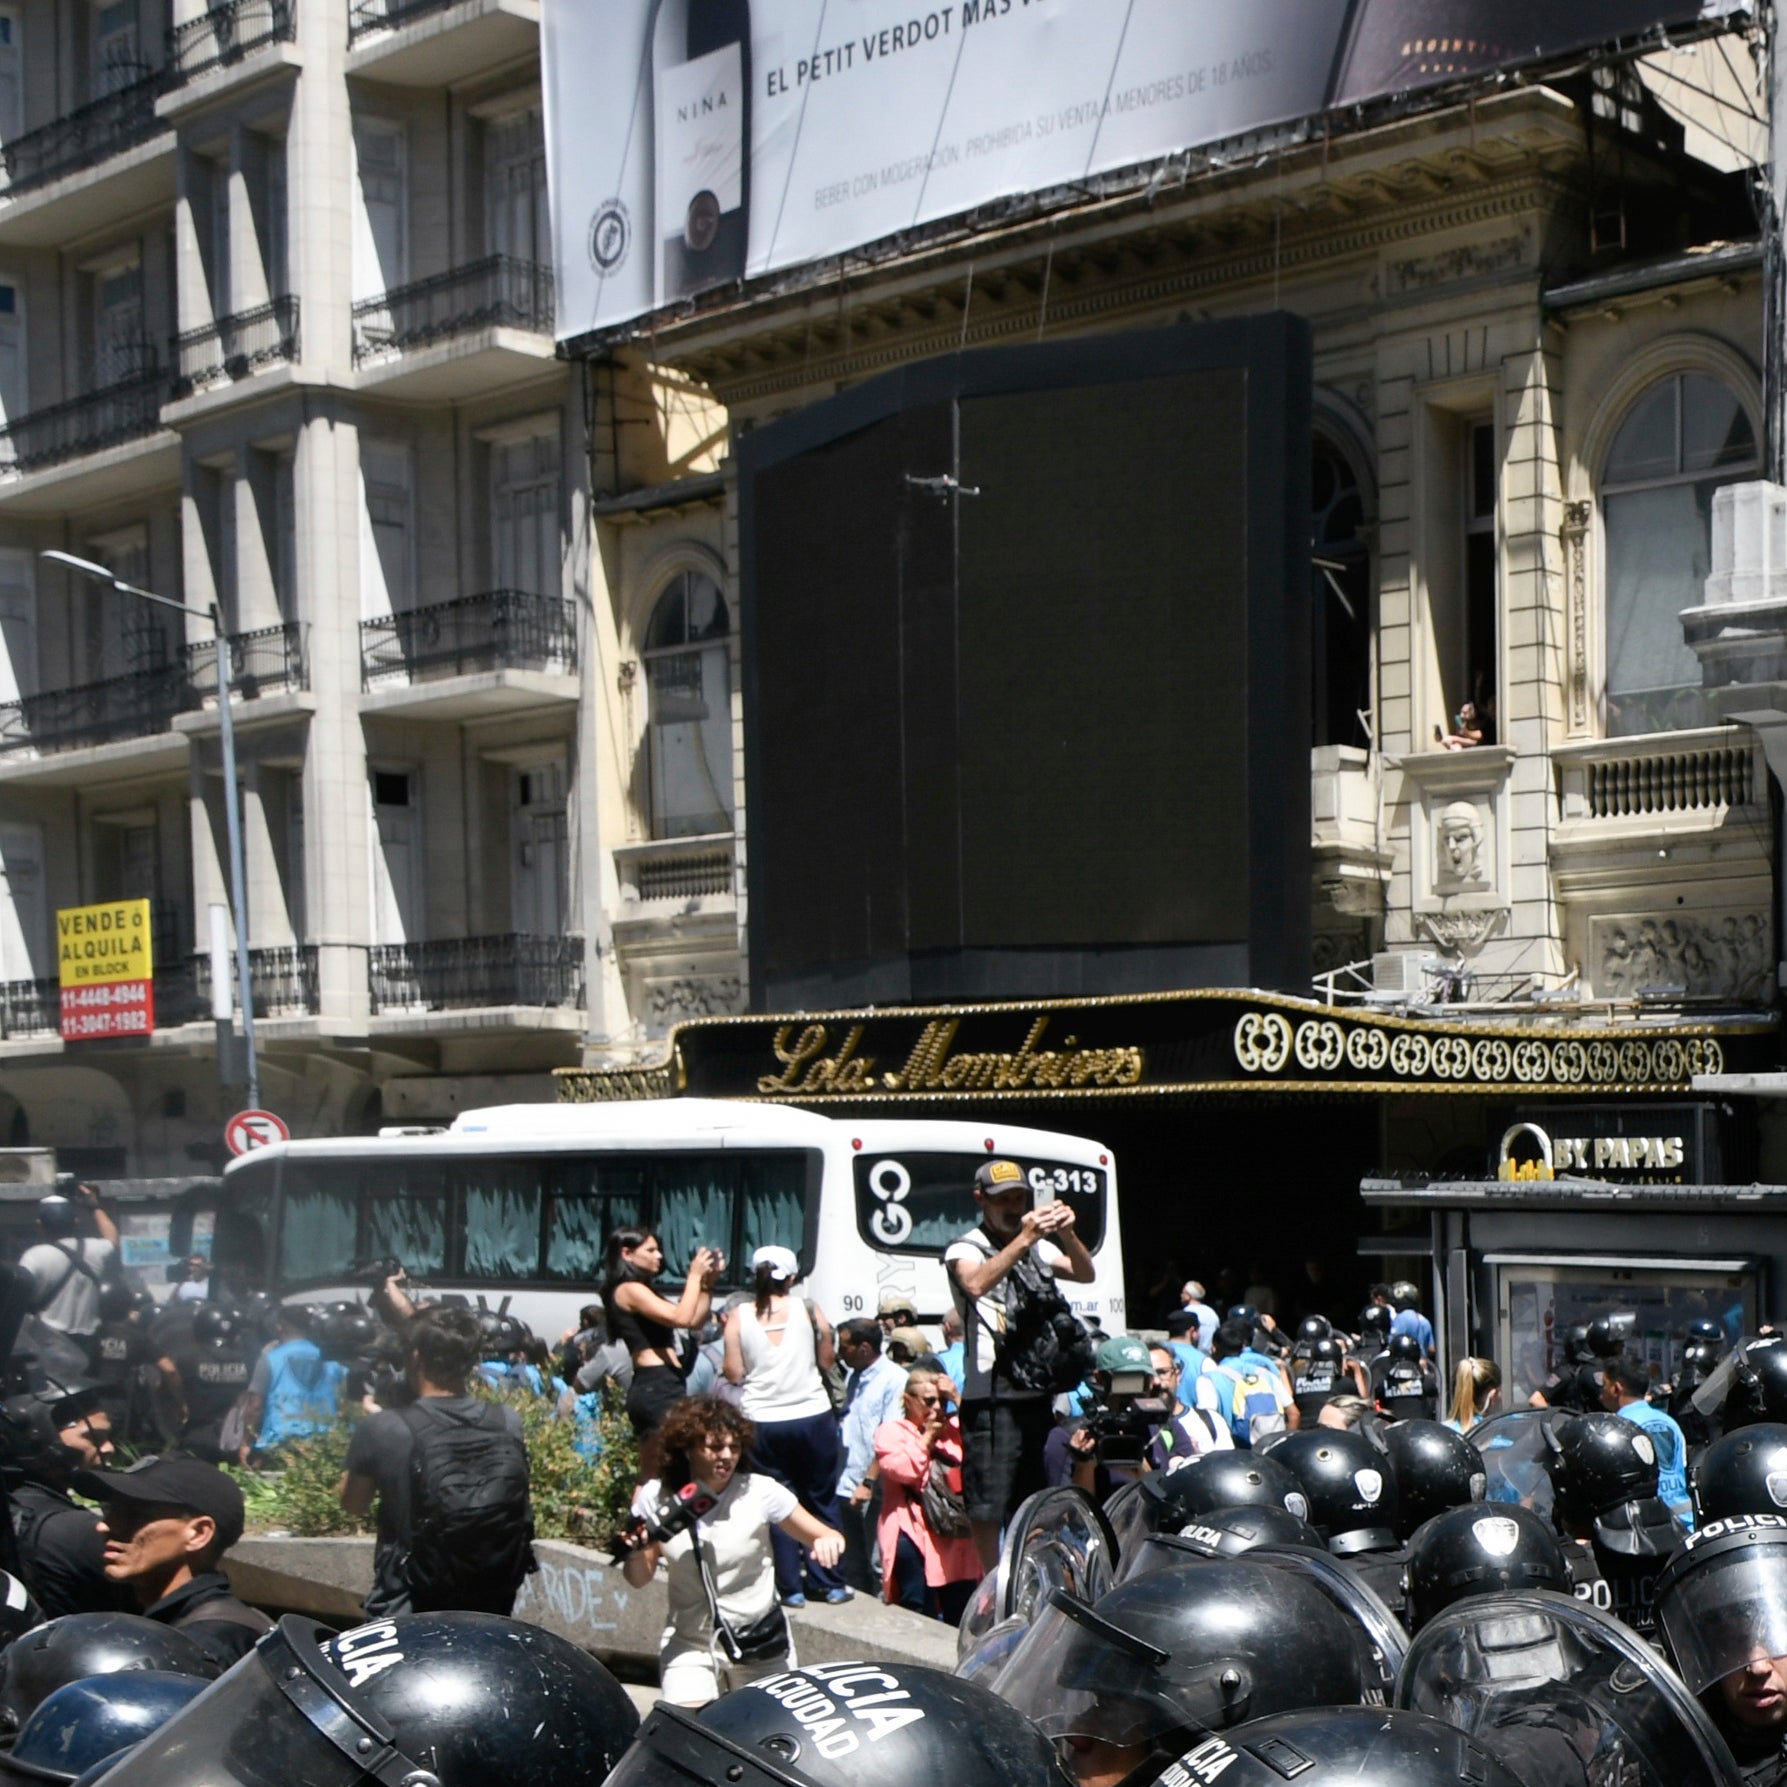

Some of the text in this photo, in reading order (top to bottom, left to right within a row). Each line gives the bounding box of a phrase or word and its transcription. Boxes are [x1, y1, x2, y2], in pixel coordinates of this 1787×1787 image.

[767, 70, 789, 97] EL
[797, 41, 856, 86] PETIT
[862, 8, 953, 62] VERDOT
[677, 91, 728, 122] NINA
[852, 173, 878, 197] CON
[965, 120, 1034, 158] PROHIBIDA
[1037, 114, 1056, 139] SU
[1058, 101, 1100, 132] VENTA
[1115, 76, 1185, 114] MENORES
[1187, 68, 1206, 94] DE
[60, 910, 126, 936] VENDE
[62, 936, 142, 960] ALQUILA
[75, 962, 129, 978] EN BLOCK
[758, 1023, 874, 1092] Lola
[1553, 1136, 1684, 1169] BY PAPAS
[843, 1295, 864, 1311] 90
[800, 1660, 924, 1743] LICIA
